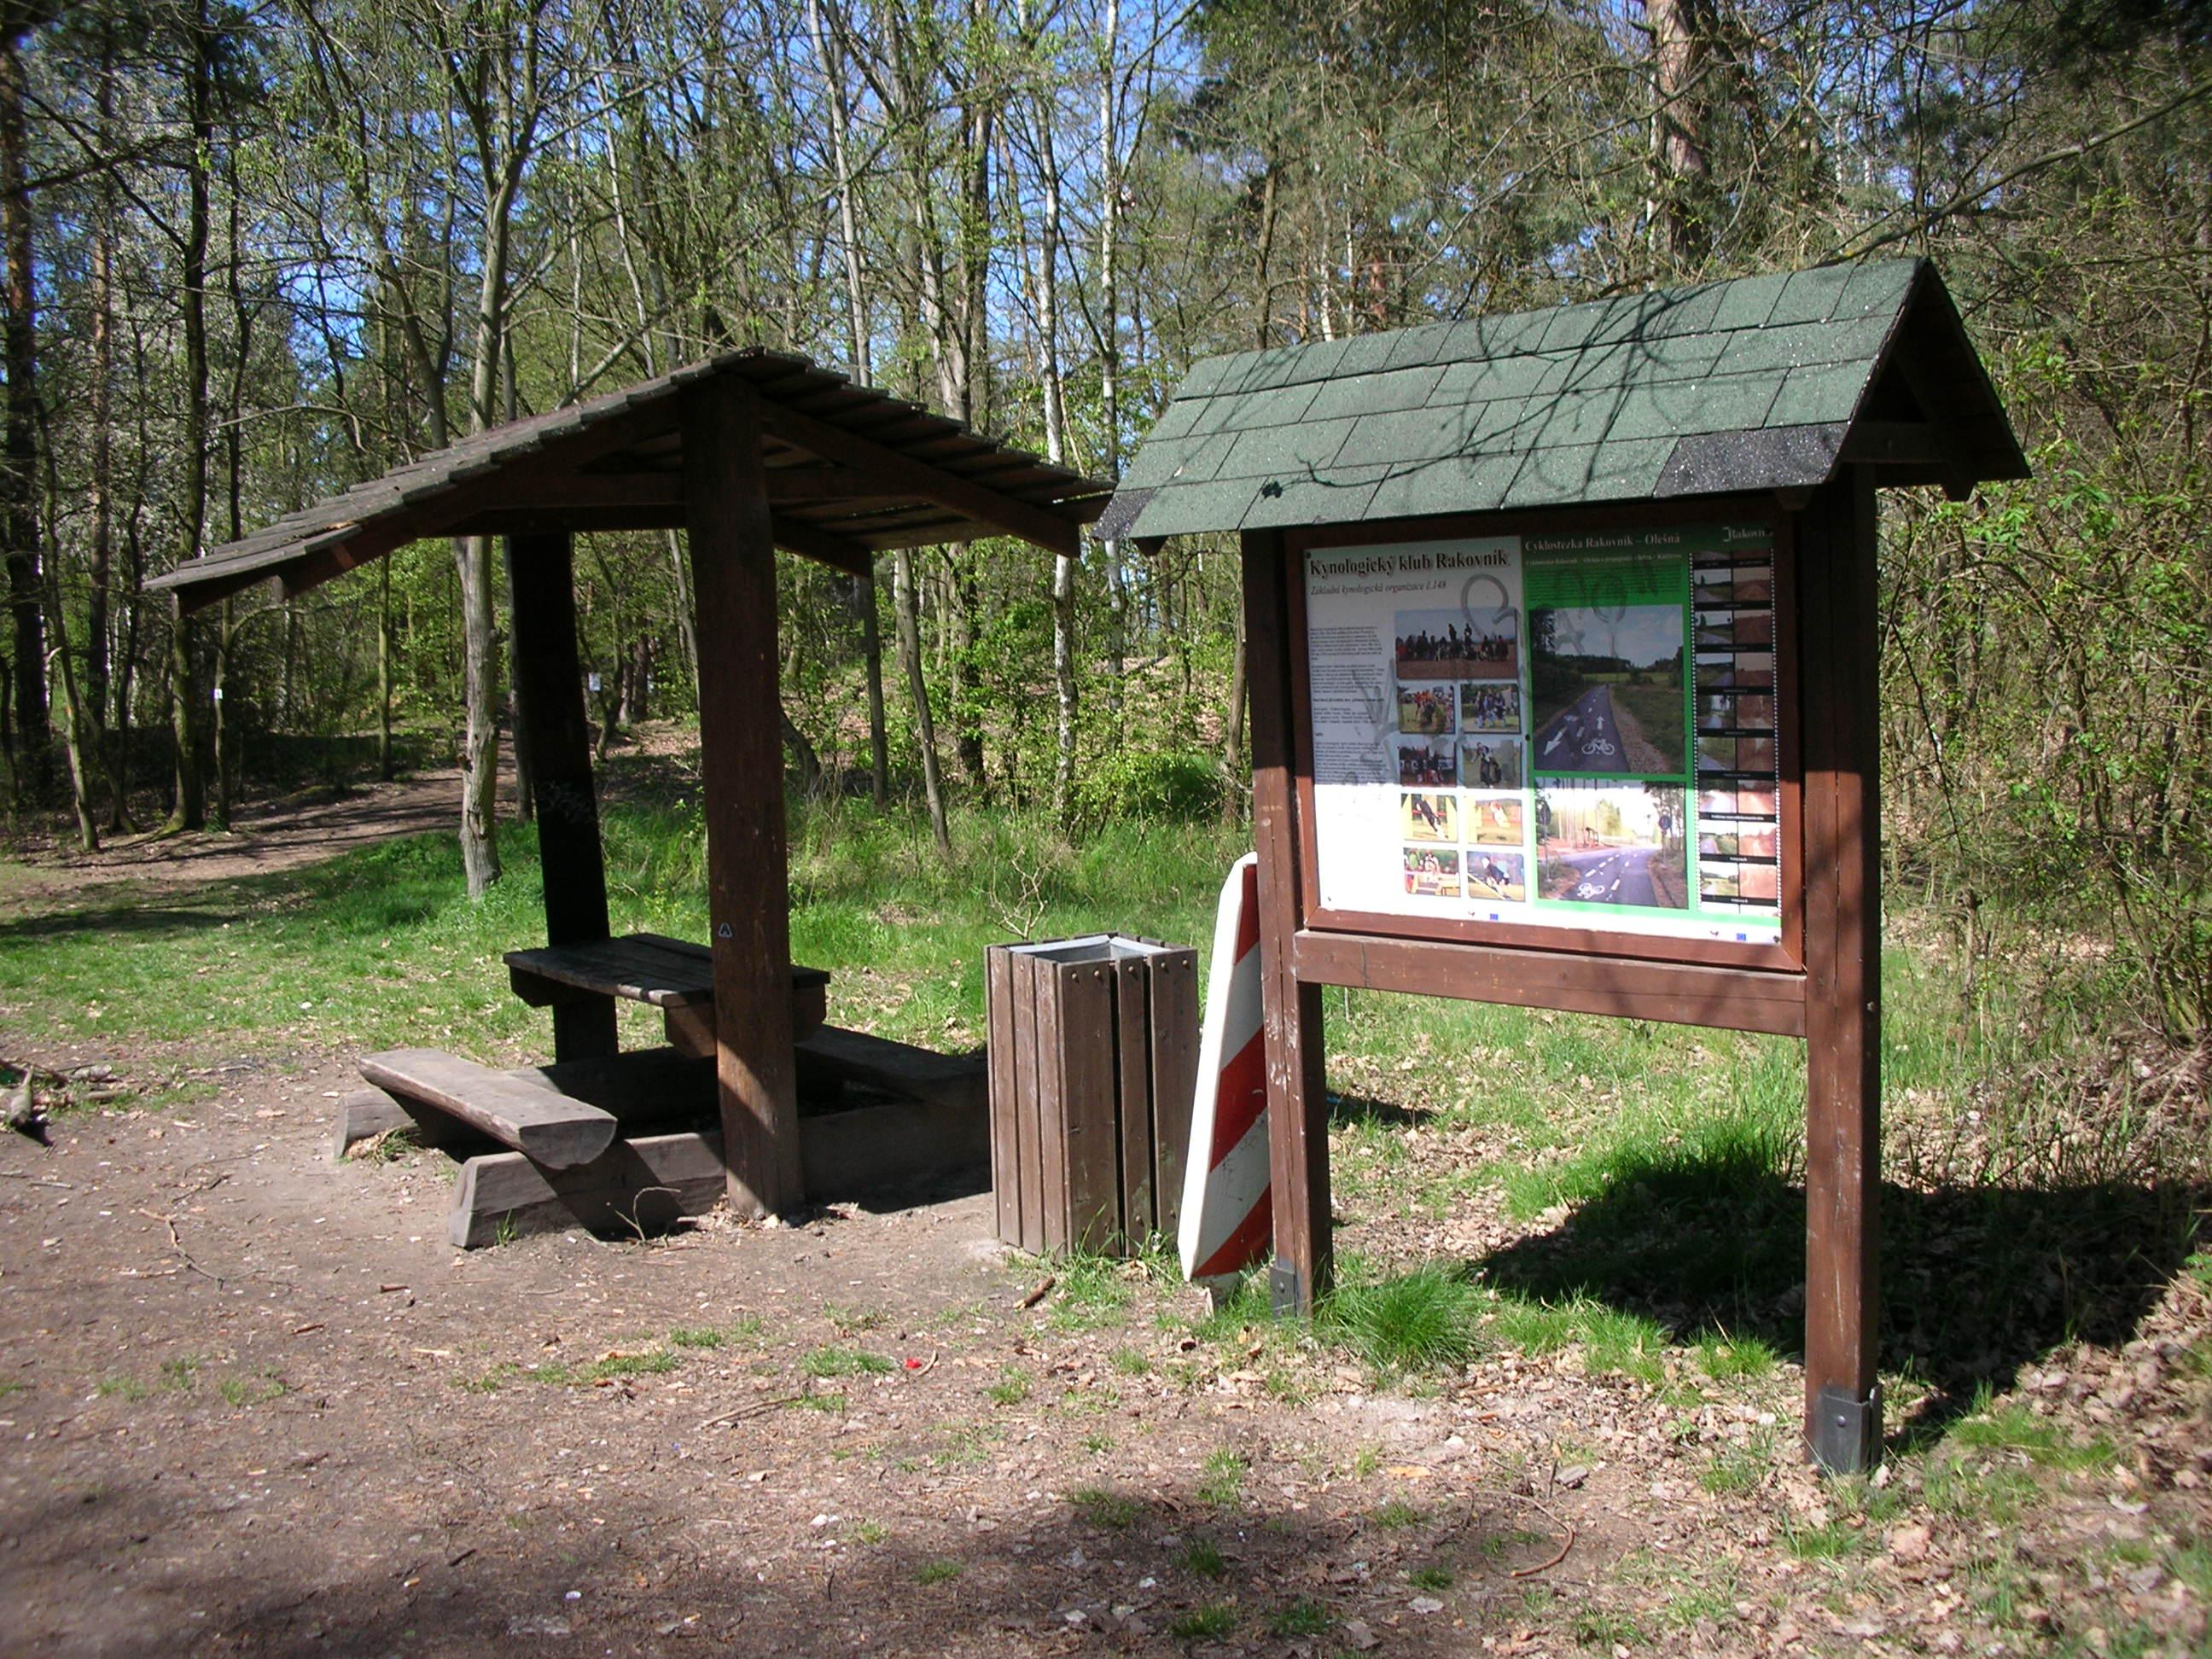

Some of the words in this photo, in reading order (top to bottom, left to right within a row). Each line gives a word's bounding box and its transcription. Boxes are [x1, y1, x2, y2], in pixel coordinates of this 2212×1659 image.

[1525, 536, 1582, 552] Cyklostezka
[1586, 534, 1633, 549] Rakovník
[1644, 531, 1680, 545] Olešná
[1310, 554, 1396, 578] Kynologický
[1398, 552, 1431, 570] klub
[1436, 548, 1508, 569] Rakovník
[1311, 583, 1341, 596] Základní
[1342, 581, 1383, 596] kynologická
[1385, 582, 1424, 594] organizace
